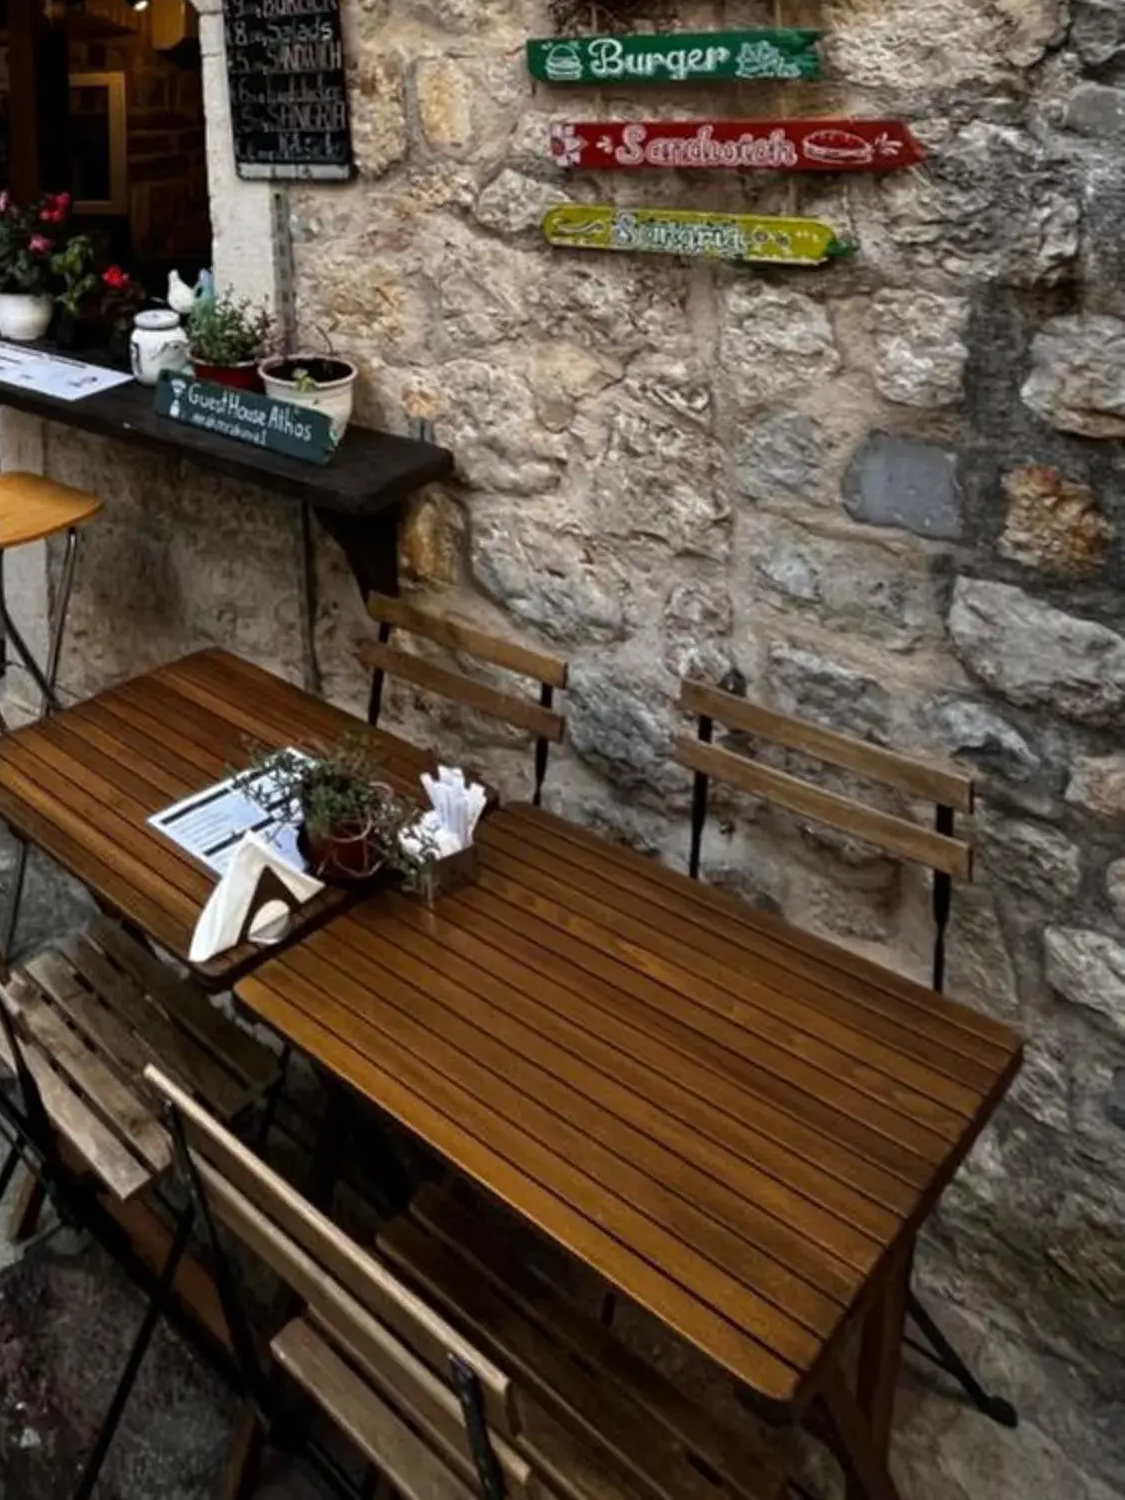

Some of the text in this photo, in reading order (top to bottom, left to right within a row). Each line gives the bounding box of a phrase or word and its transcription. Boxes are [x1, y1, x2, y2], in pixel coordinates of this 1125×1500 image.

[587, 38, 730, 81] Burger
[614, 123, 799, 168] Sandwich
[267, 404, 313, 442] Athos
